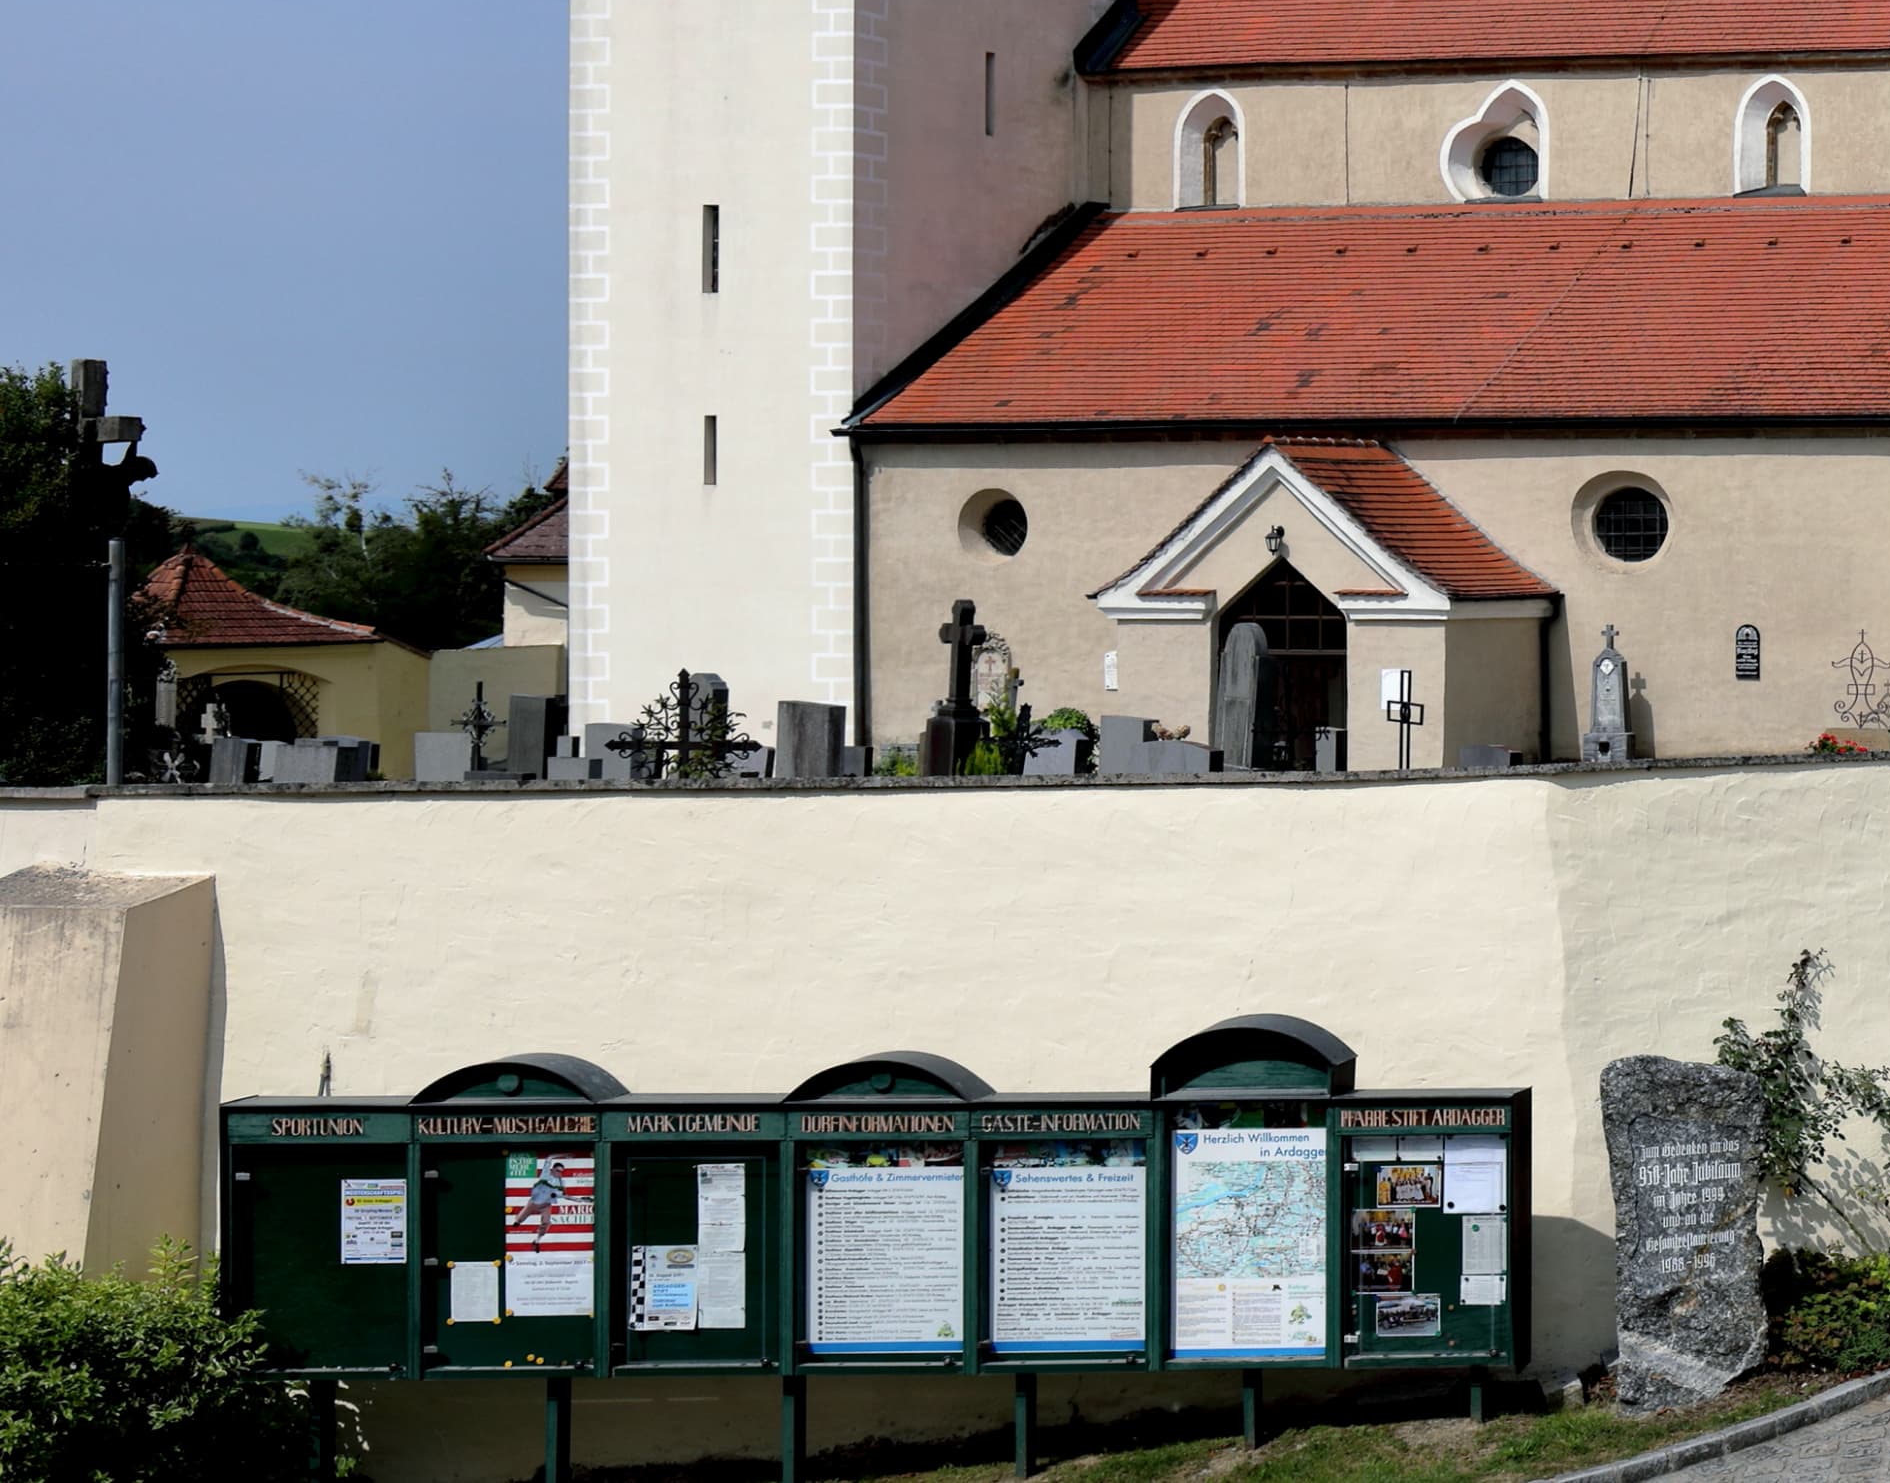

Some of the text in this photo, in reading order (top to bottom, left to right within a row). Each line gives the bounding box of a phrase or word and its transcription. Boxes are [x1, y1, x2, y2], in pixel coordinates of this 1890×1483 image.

[271, 1117, 364, 1136] SPORTUNION
[627, 1114, 761, 1133] MARKTGEMEINDE
[801, 1115, 955, 1134] DORFINFORMATIONEN
[1340, 1108, 1506, 1128] PFARRE STIFT ARDAGGER
[1203, 1132, 1310, 1144] Herzlich Willkommen
[1260, 1146, 1325, 1159] in Ardagge
[1662, 1141, 1707, 1158] Gedenken
[1723, 1138, 1740, 1152] das
[831, 1172, 872, 1183] Gasthöfe
[876, 1173, 884, 1182] &
[1015, 1173, 1134, 1184] Sehenswertes & Freizeit
[1692, 1160, 1741, 1184] Jubiläum
[1653, 1187, 1725, 1209] im Jahre 1999
[551, 1215, 594, 1225] SACHE
[1662, 1210, 1714, 1228] und an die
[1694, 1253, 1716, 1269] 1996
